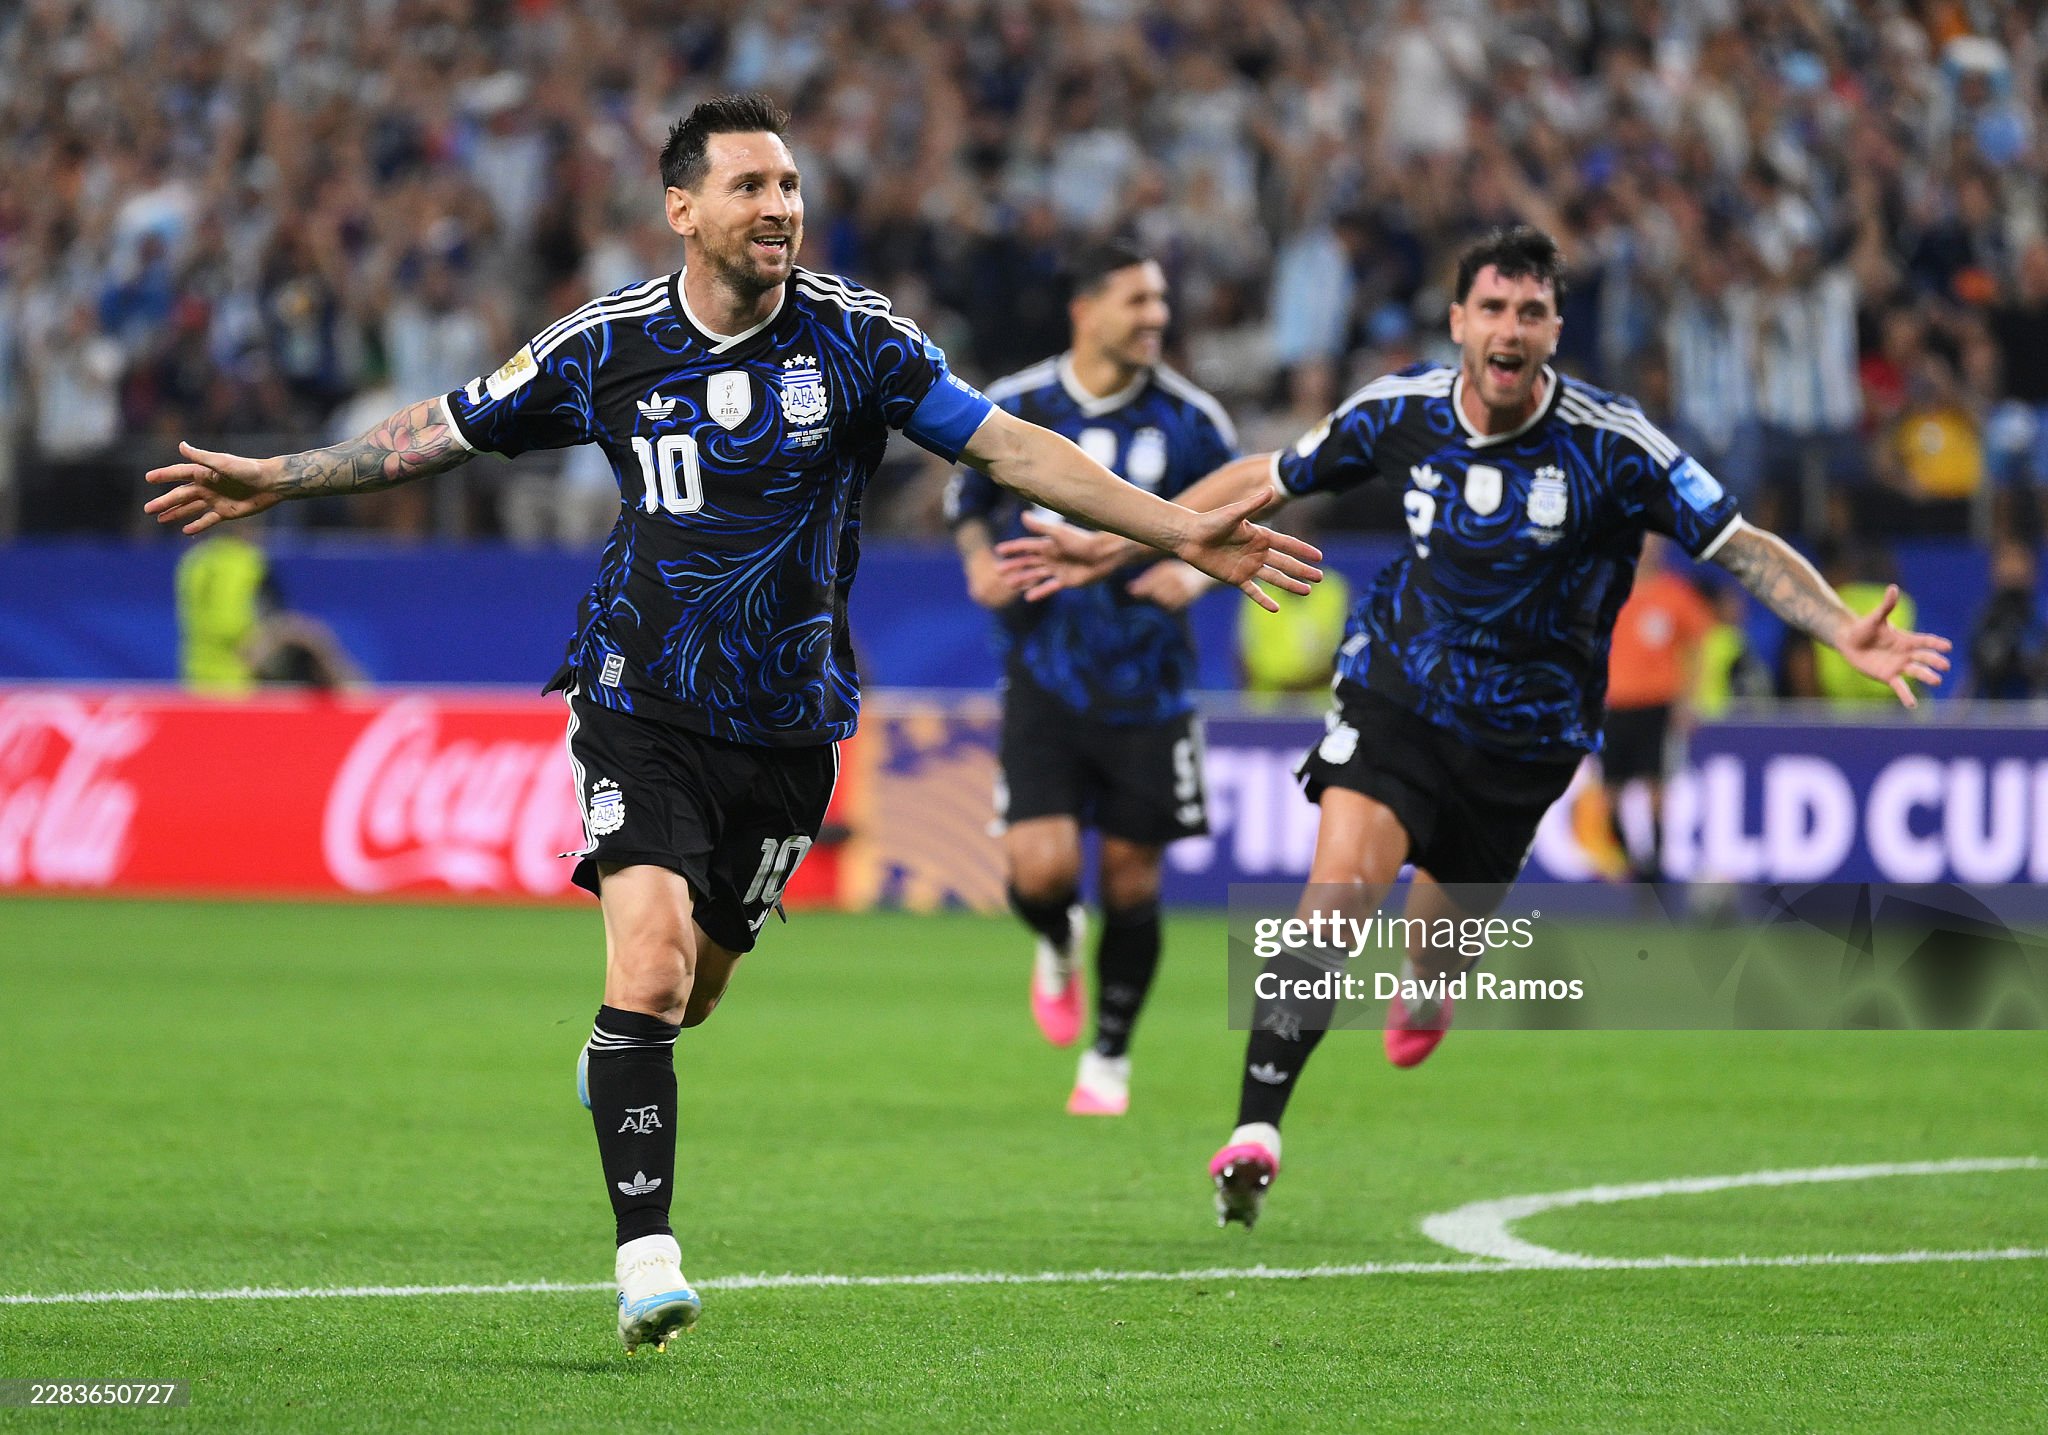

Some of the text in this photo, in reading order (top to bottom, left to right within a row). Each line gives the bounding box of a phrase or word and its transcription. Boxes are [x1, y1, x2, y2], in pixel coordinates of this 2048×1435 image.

[720, 407, 739, 415] FIFA
[792, 385, 817, 408] AFA
[631, 434, 704, 515] 10
[596, 803, 615, 821] AFA
[1866, 754, 2048, 884] CU
[743, 835, 812, 905] 10
[618, 1105, 662, 1134] AFA
